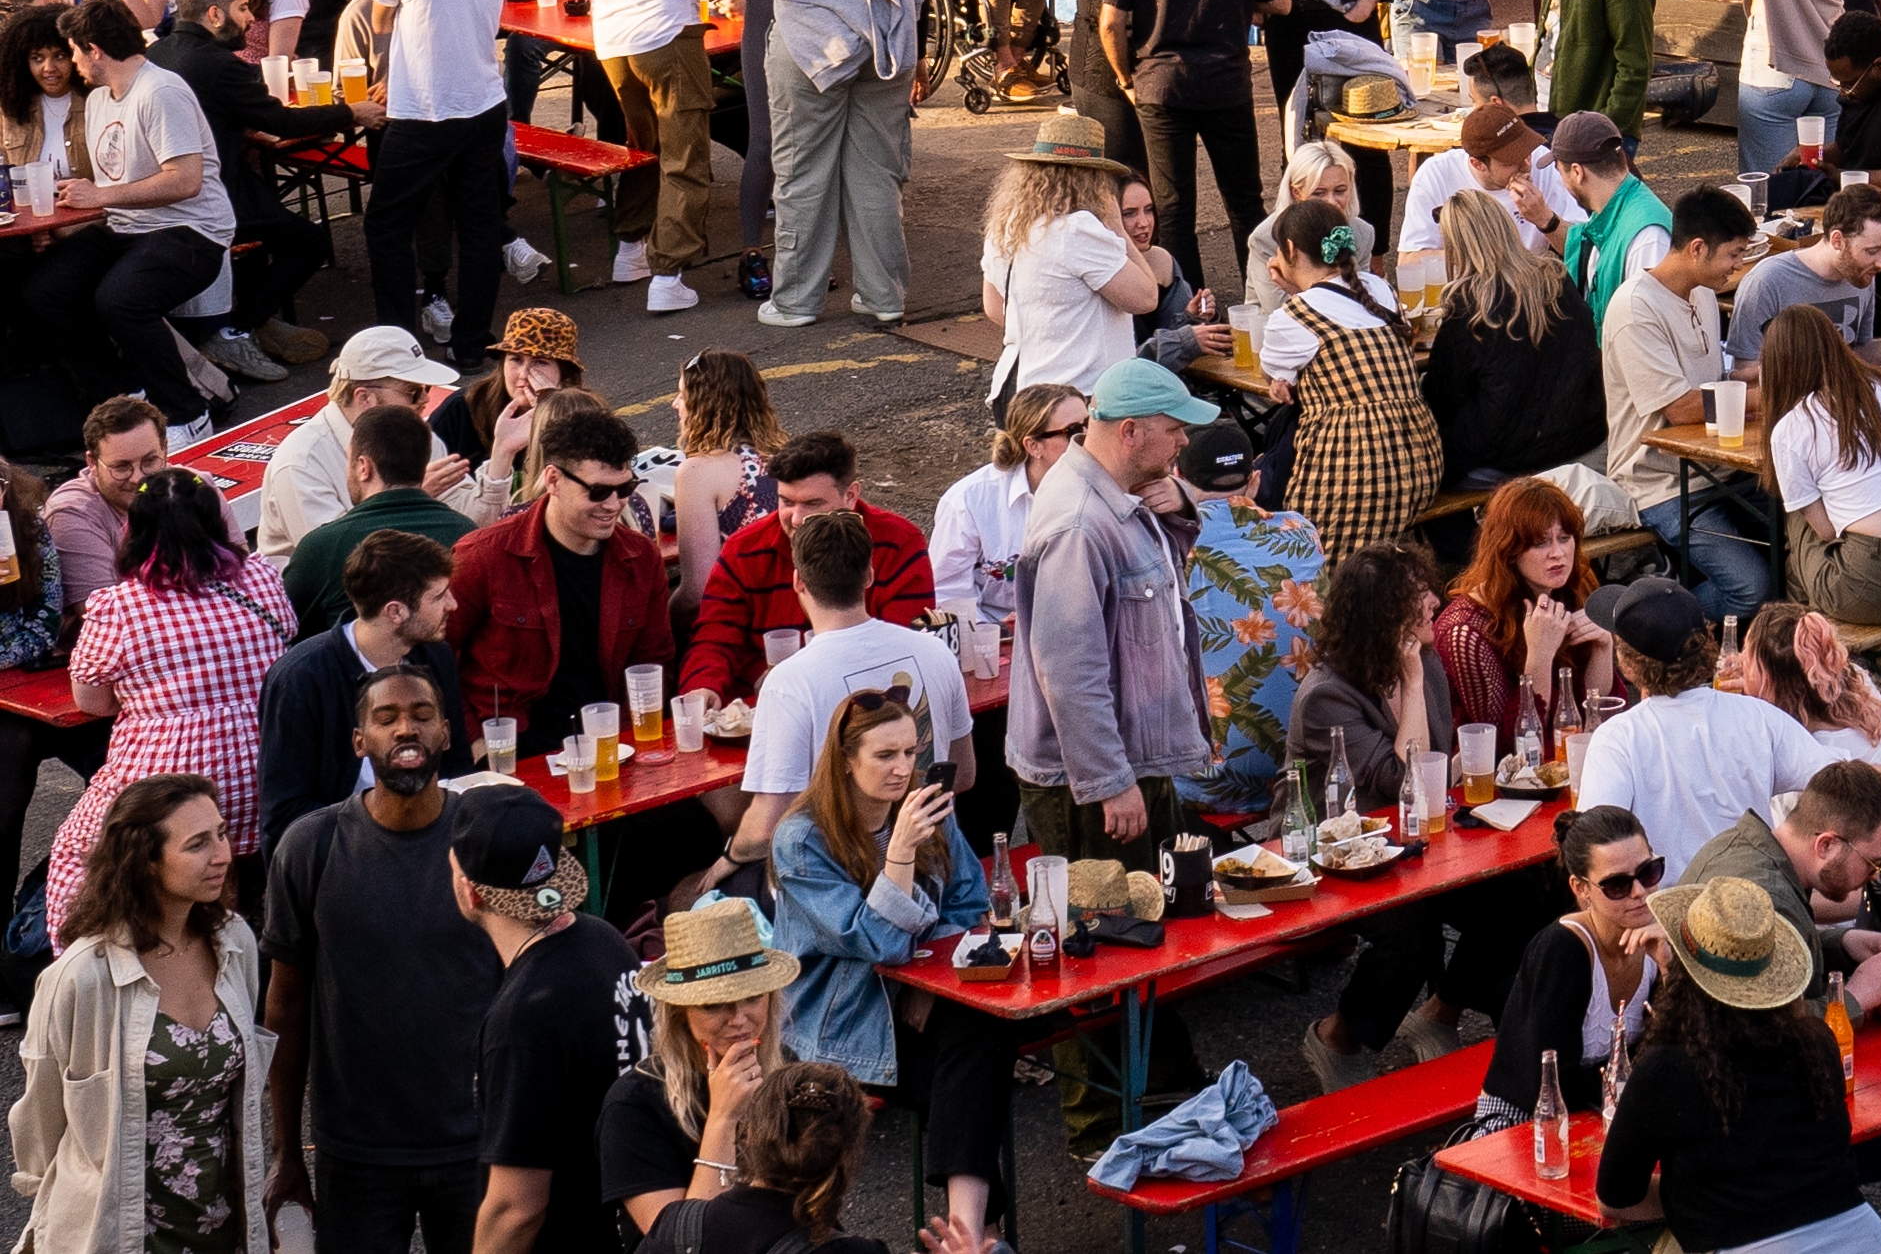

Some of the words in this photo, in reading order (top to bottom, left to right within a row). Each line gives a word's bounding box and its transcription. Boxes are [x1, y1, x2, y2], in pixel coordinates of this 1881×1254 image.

[614, 969, 644, 1013] TACO
[694, 960, 739, 979] JARRITOS
[614, 1015, 633, 1076] THE
